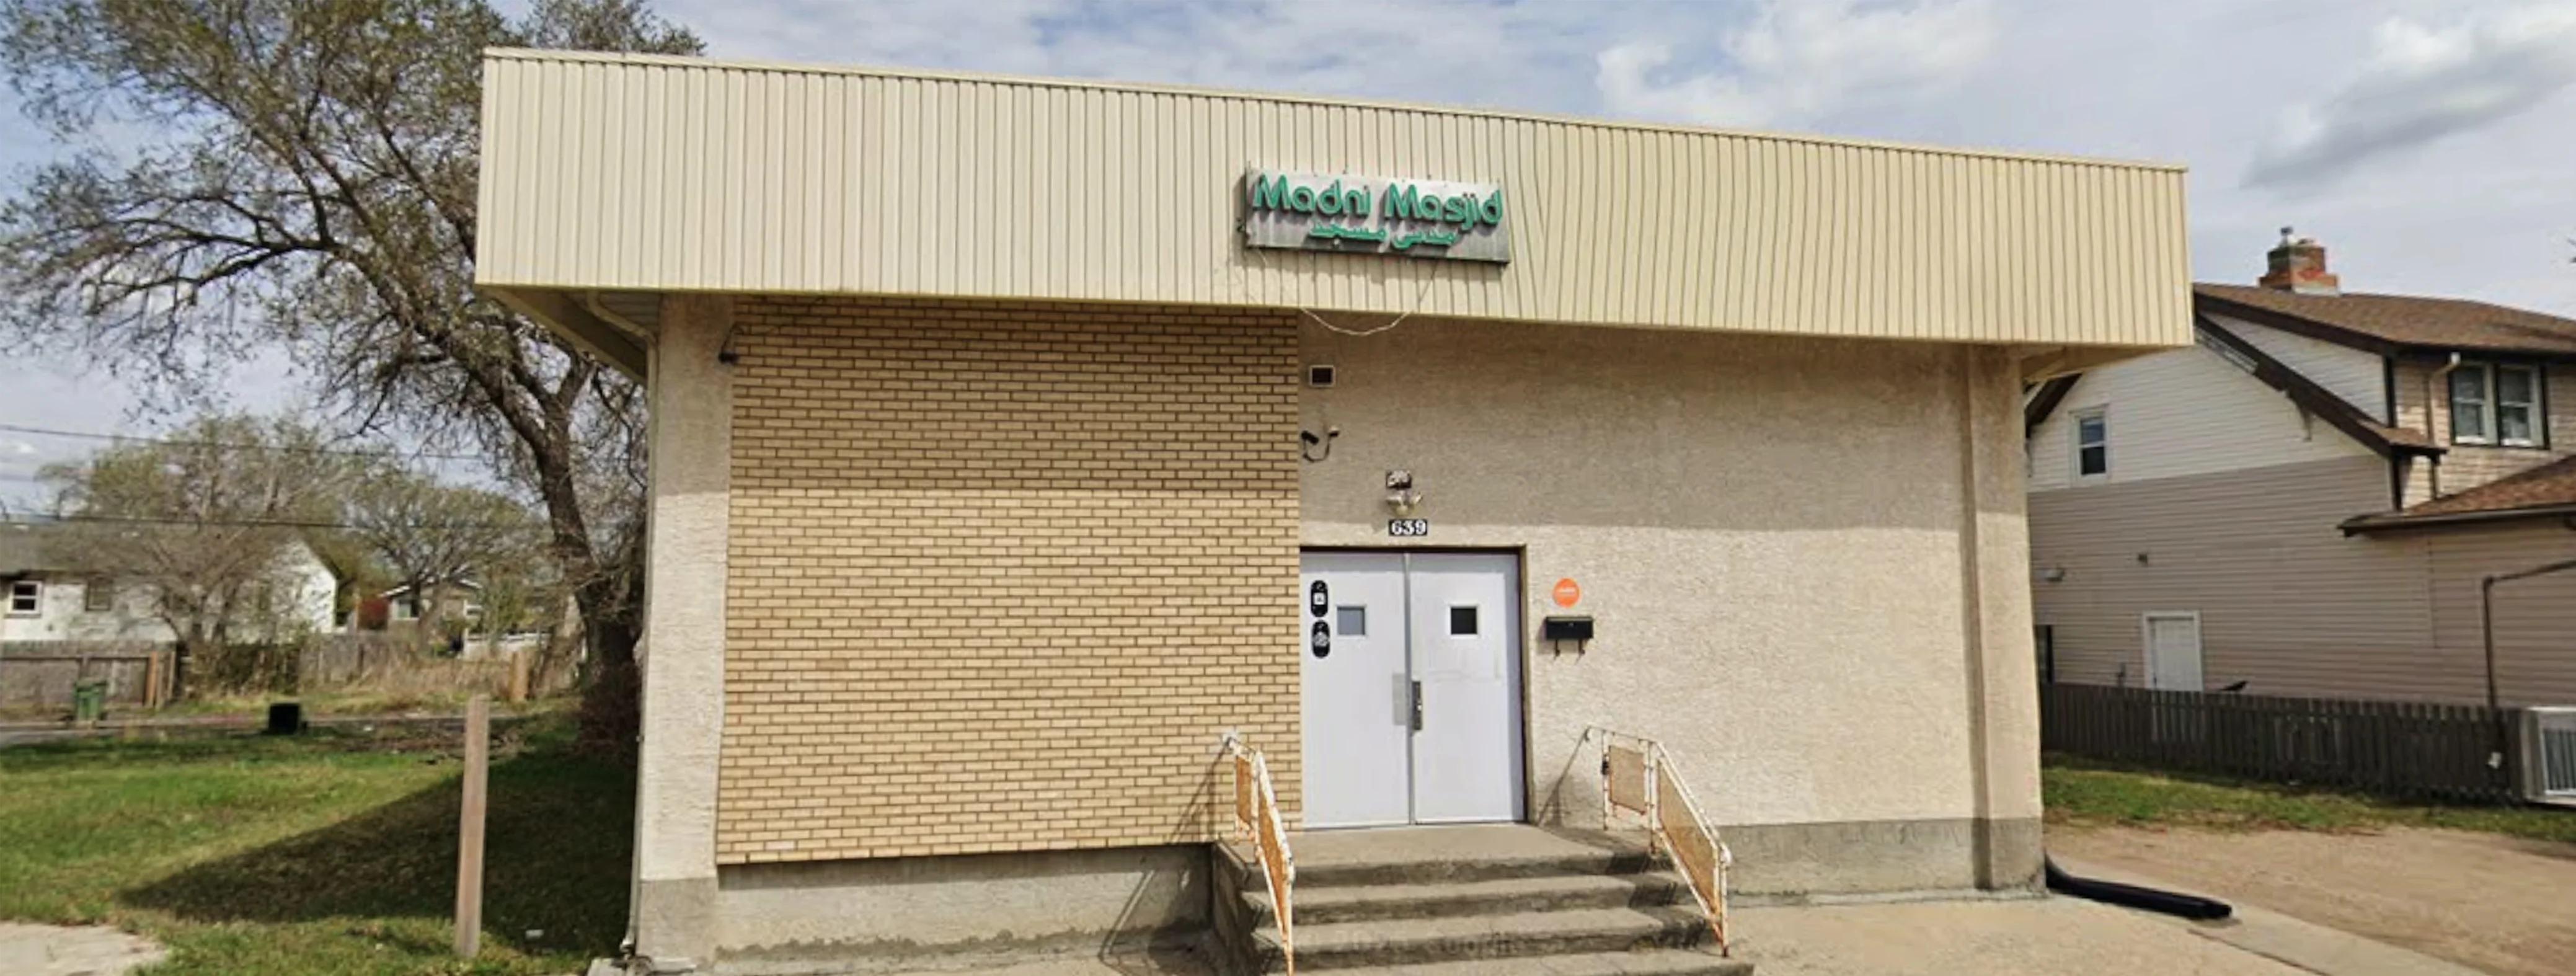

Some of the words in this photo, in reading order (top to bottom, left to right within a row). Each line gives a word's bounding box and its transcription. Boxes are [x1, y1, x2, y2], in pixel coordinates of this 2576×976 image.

[1252, 173, 1371, 215] Madni
[1385, 182, 1503, 231] Masjid
[1309, 221, 1387, 245] مسجد
[1391, 520, 1427, 535] 639
